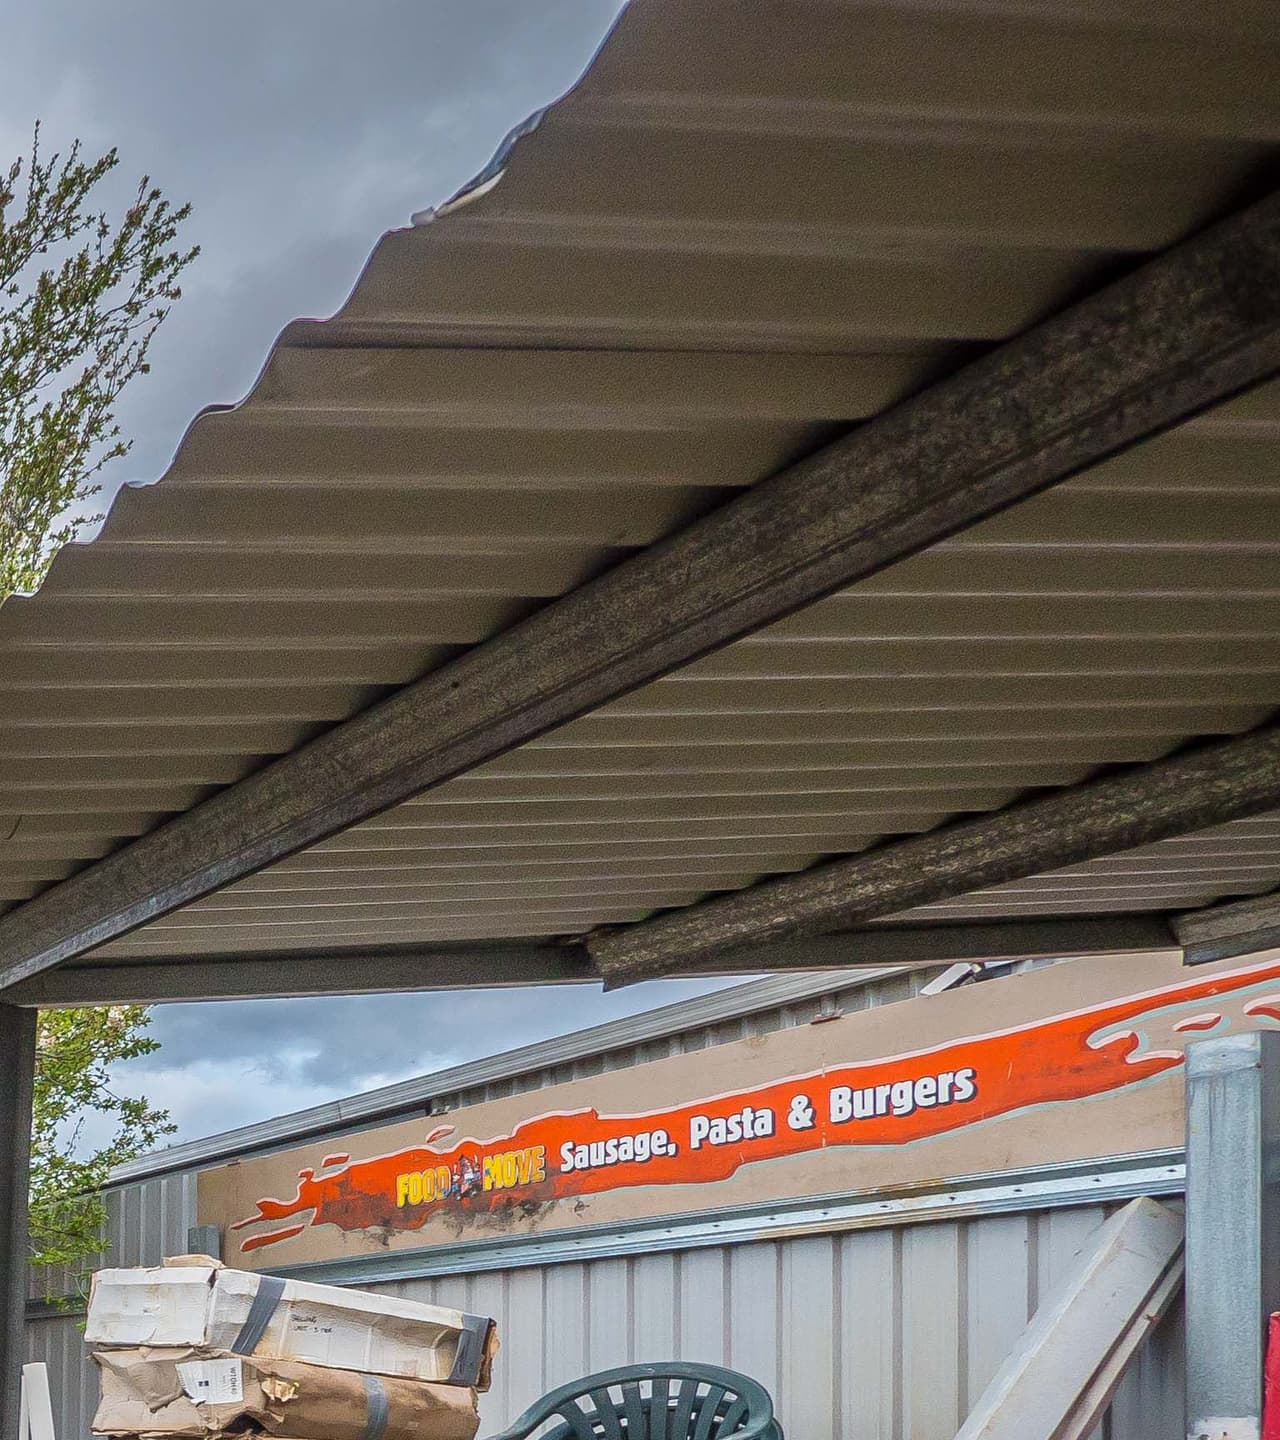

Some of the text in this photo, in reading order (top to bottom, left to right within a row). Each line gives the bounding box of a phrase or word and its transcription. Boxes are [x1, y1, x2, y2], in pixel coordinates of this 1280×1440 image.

[560, 1068, 975, 1173] Sausage, Pasta & Burgers
[396, 1146, 545, 1208] FOOD MOVE
